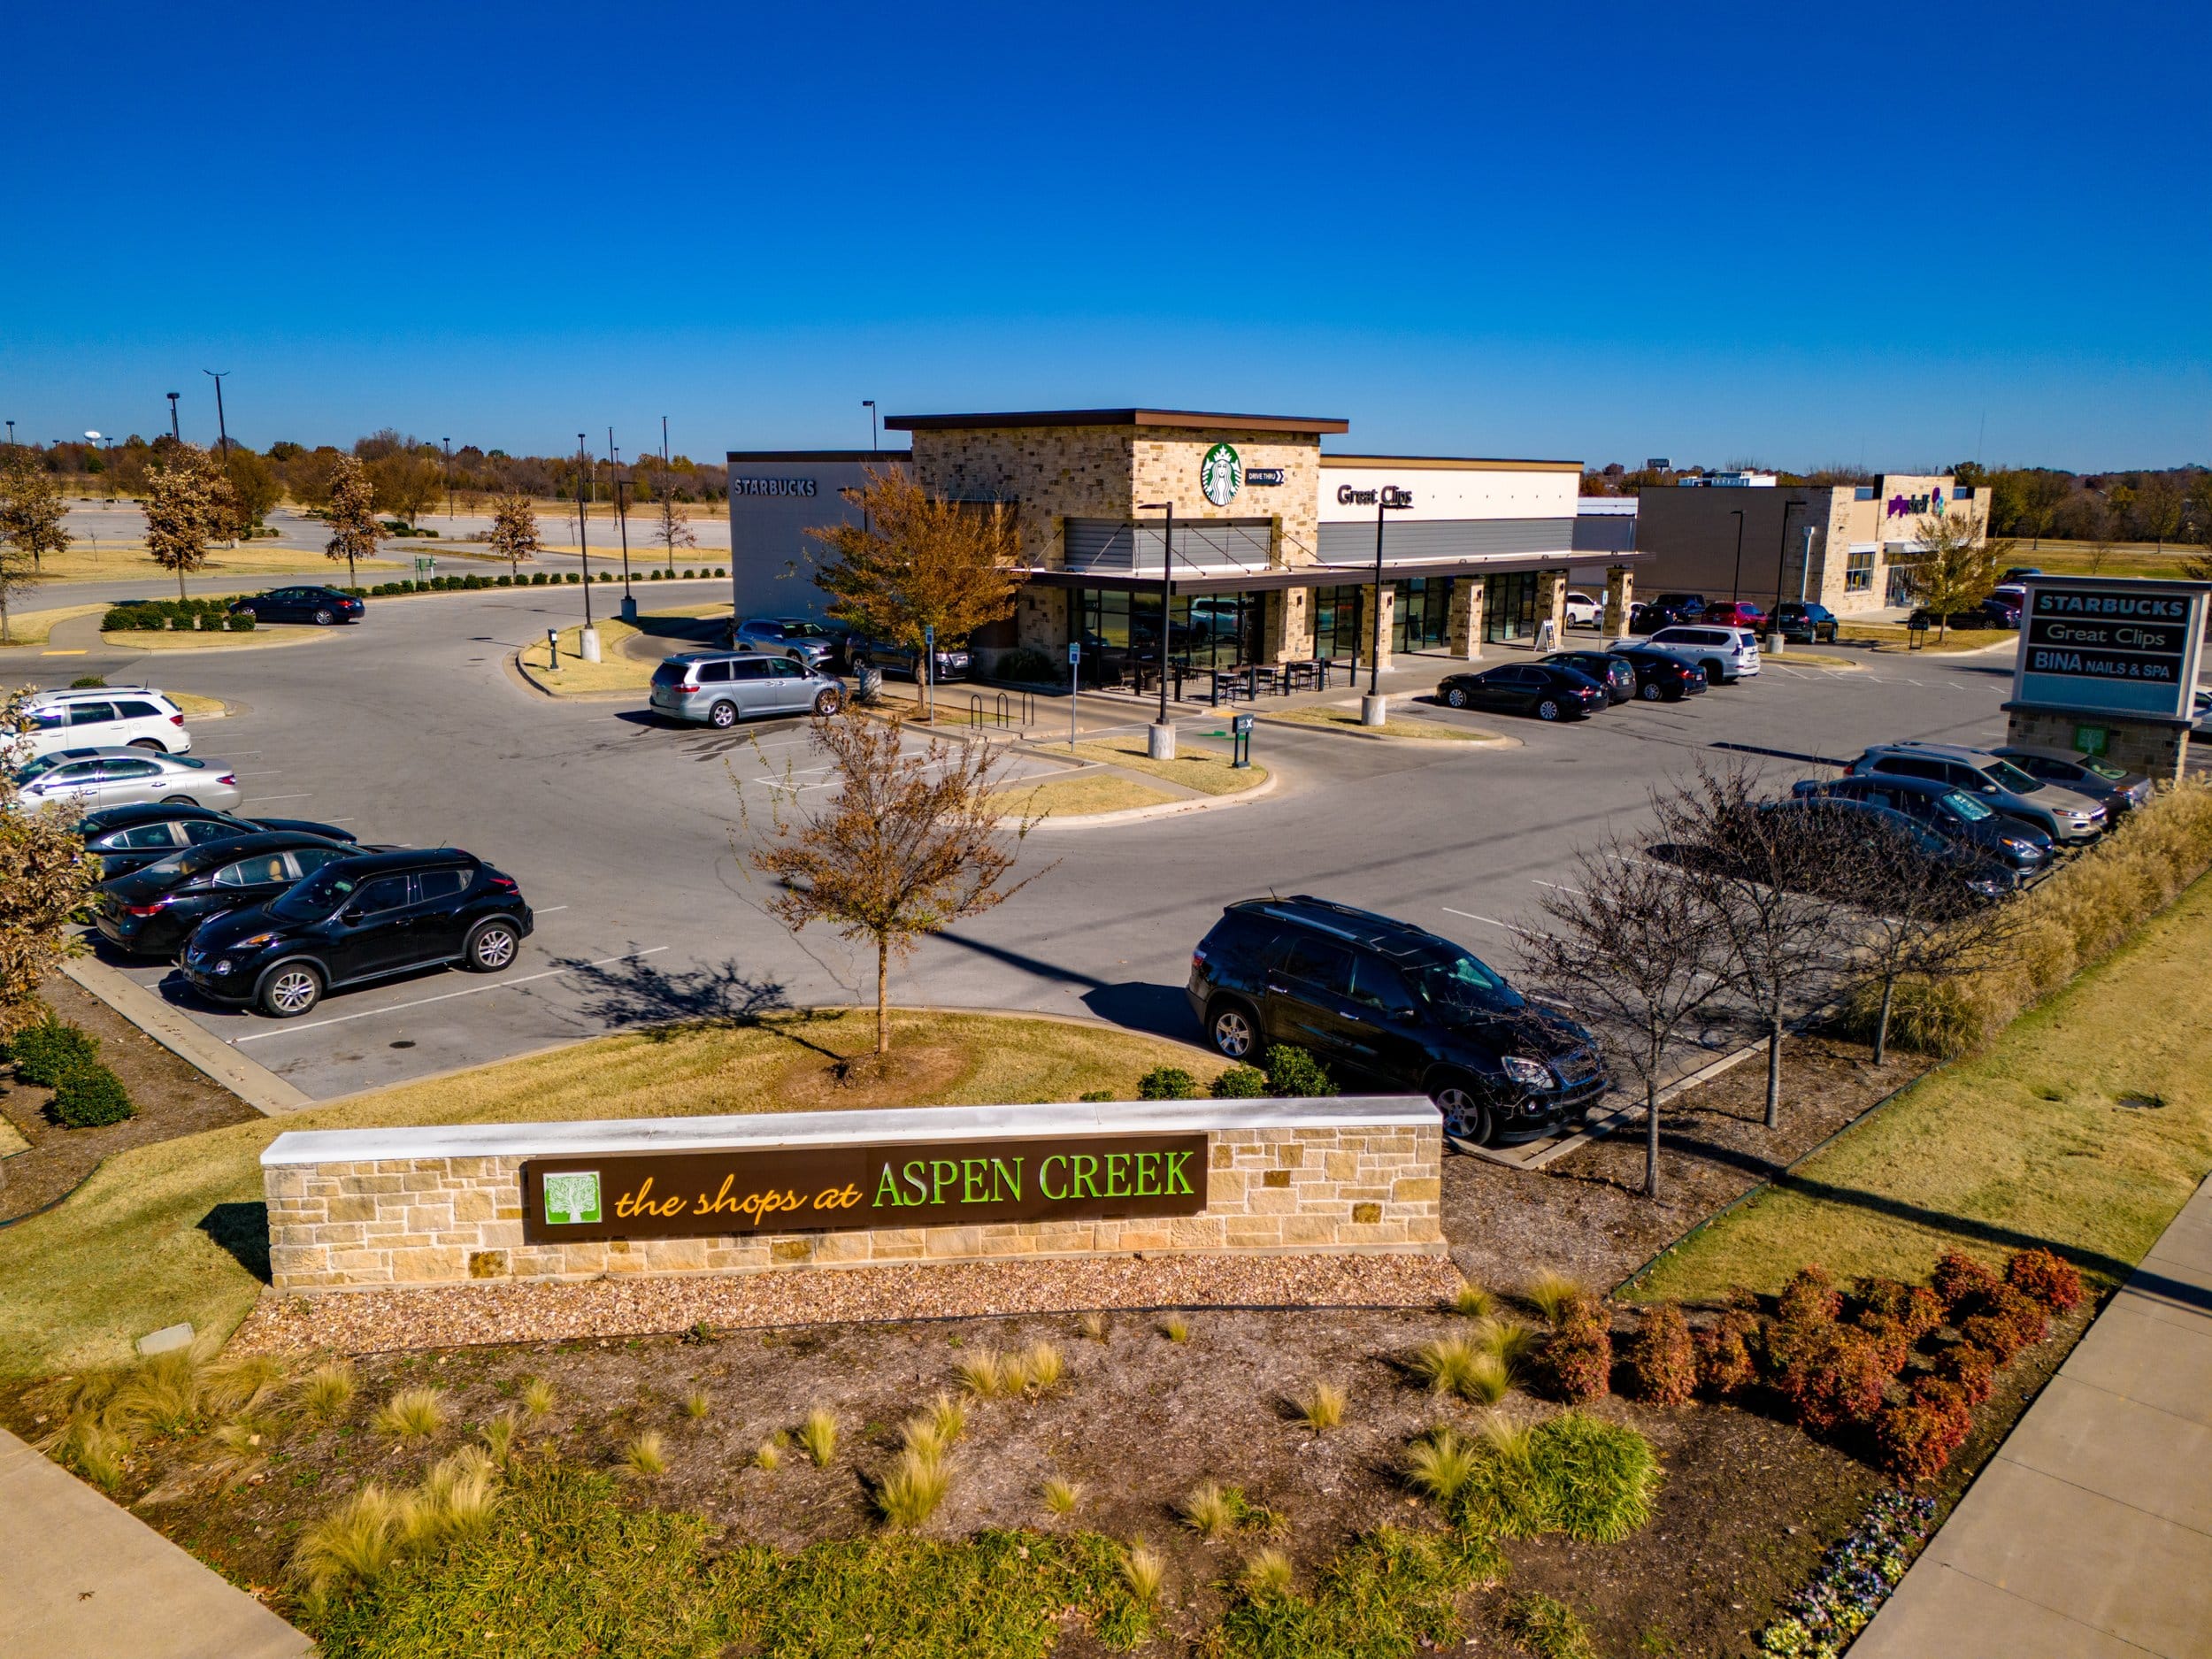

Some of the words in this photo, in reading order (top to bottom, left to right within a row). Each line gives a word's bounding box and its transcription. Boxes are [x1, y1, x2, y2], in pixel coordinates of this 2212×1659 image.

[734, 479, 816, 496] STARBUCKS
[1337, 484, 1378, 505] Great
[1381, 485, 1412, 506] Clips
[2039, 595, 2184, 617] STARBUCKS
[2047, 623, 2108, 643] Great
[2116, 627, 2166, 649] Clips
[2034, 650, 2082, 672] BINA
[2085, 660, 2126, 675] NAILS
[2129, 663, 2139, 677] &
[2143, 664, 2170, 678] SPA
[615, 1176, 687, 1218] the
[693, 1173, 808, 1227] shops
[813, 1183, 863, 1211] at
[871, 1156, 1025, 1208] ASPEN
[1039, 1150, 1194, 1200] CREEK
